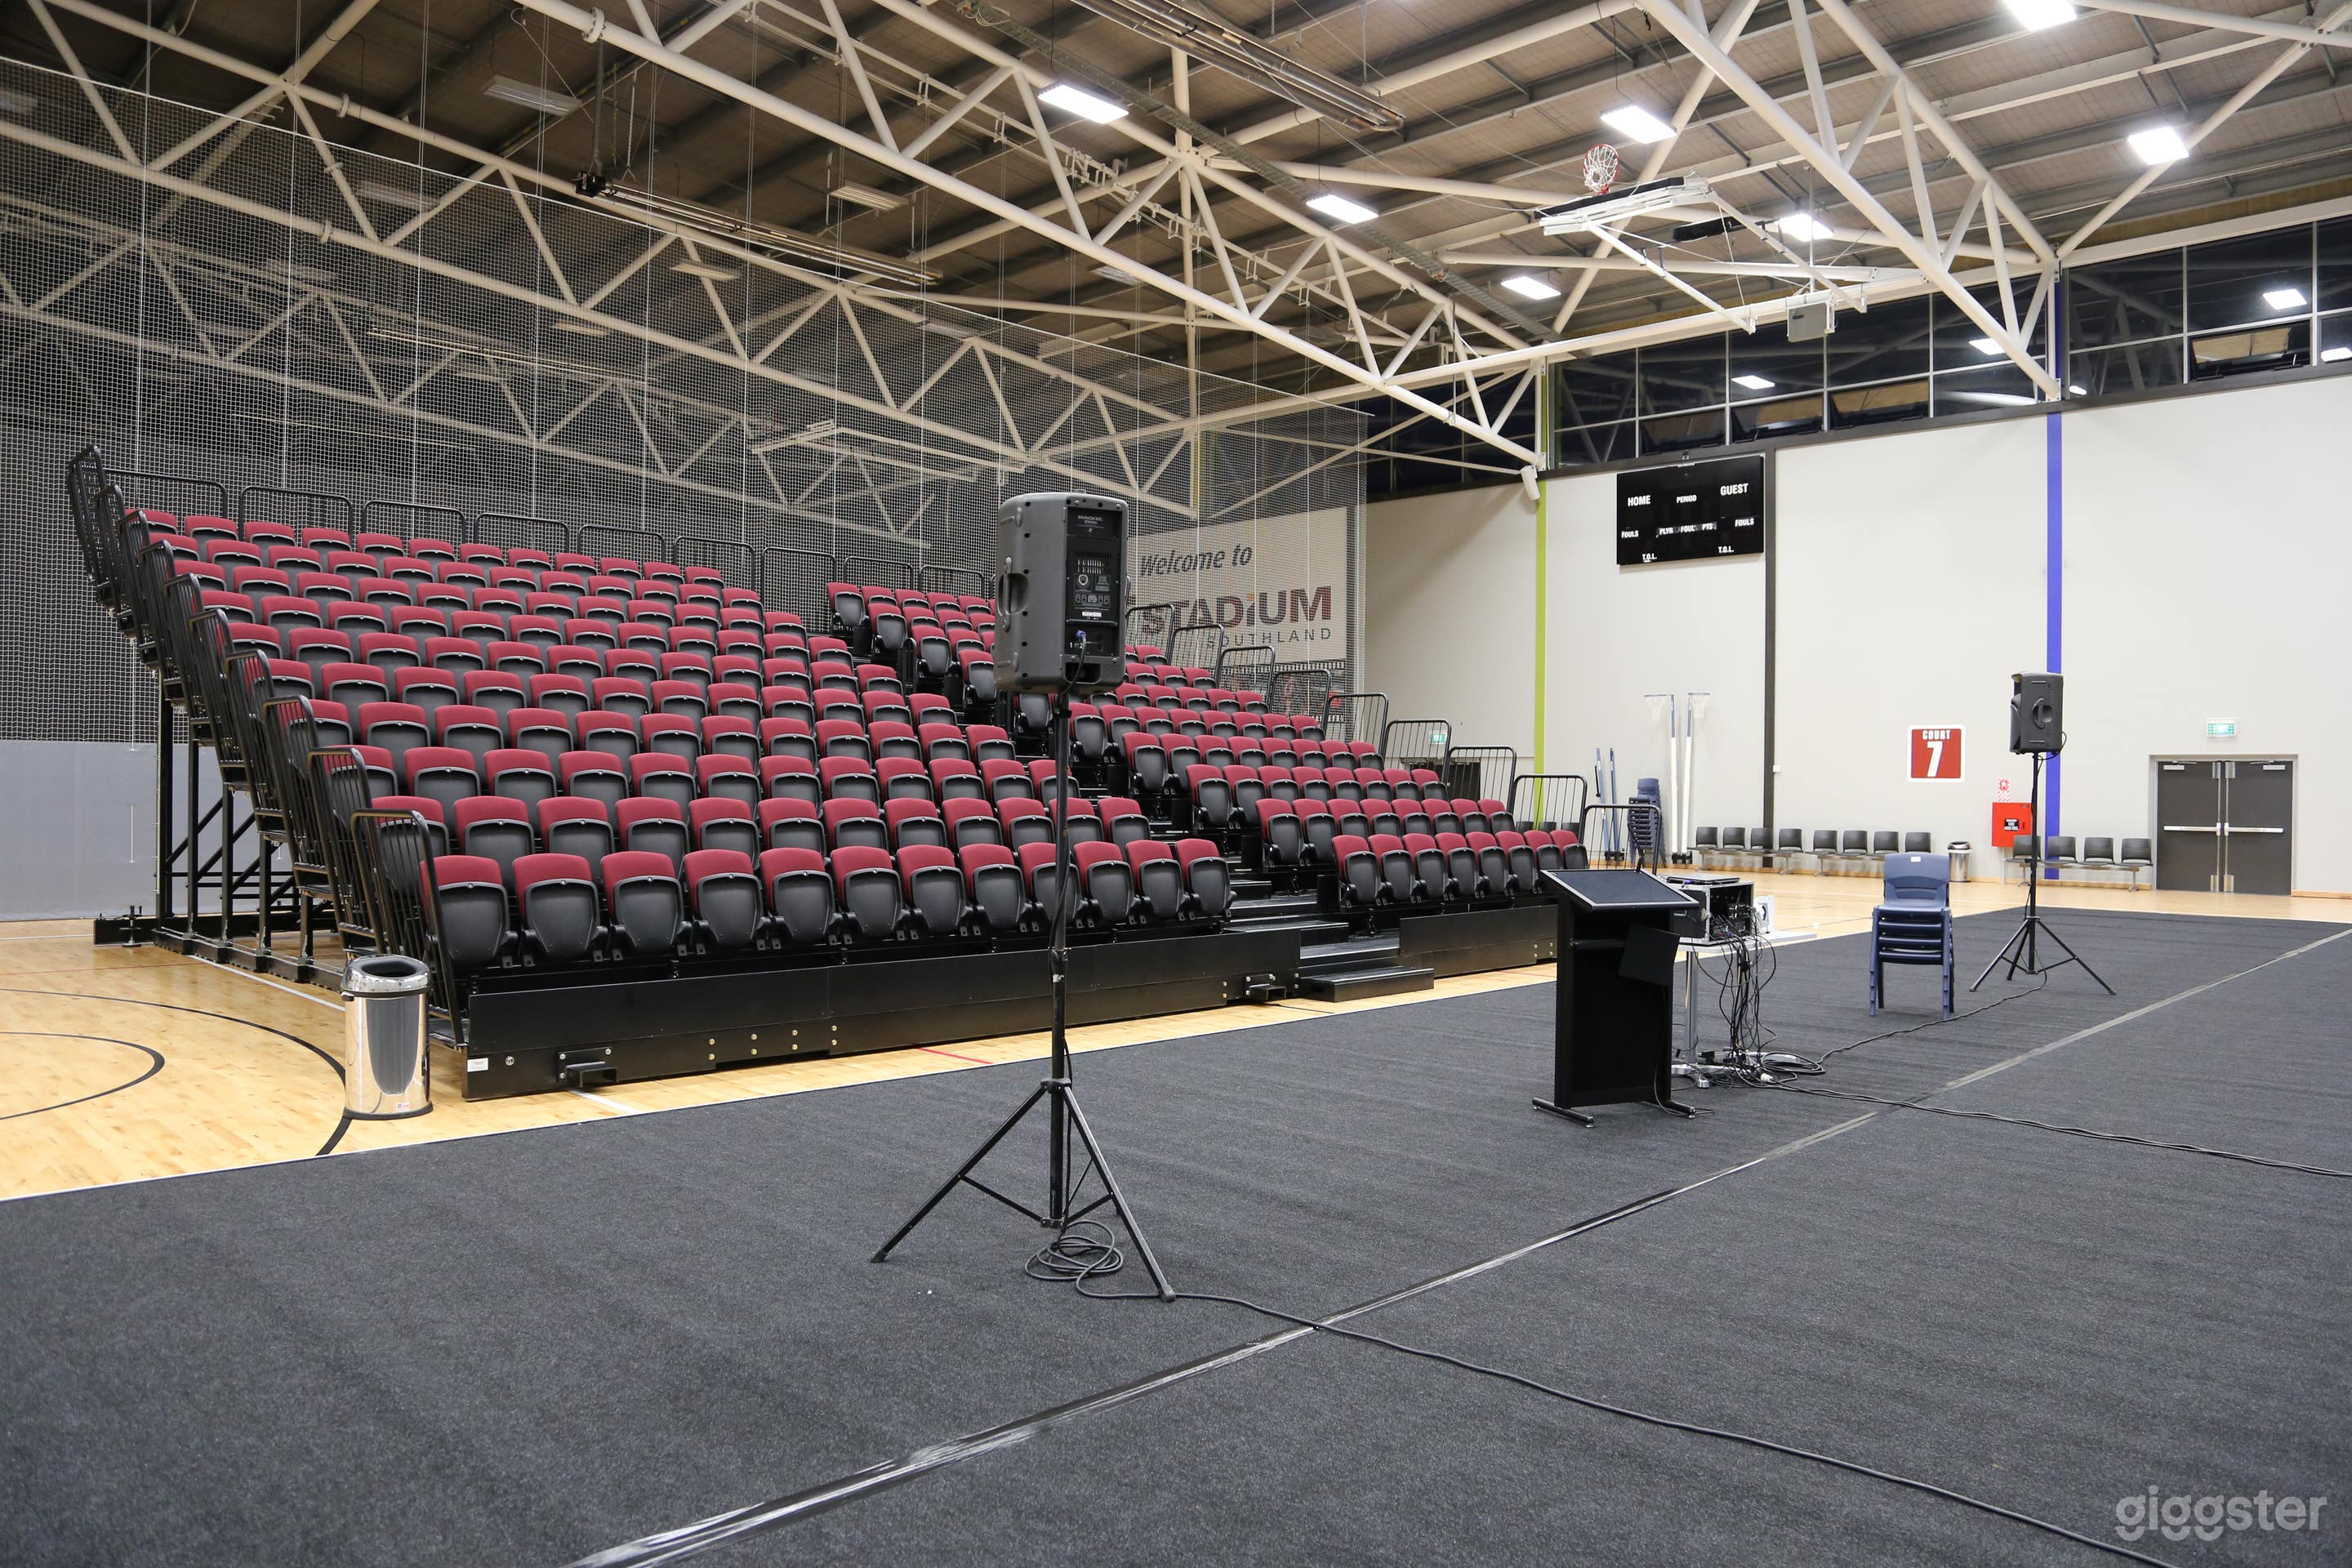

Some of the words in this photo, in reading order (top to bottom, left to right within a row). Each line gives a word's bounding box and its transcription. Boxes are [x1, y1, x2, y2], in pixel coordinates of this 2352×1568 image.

[1720, 483, 1748, 496] GUEST
[1628, 495, 1651, 506] HOME
[1677, 494, 1697, 503] PERIOD
[1735, 518, 1754, 527] FOULS
[1621, 530, 1639, 538] FOULS
[1659, 526, 1673, 535] PLYR
[1702, 523, 1713, 531] PTS
[1718, 546, 1735, 554] T.O.L.
[1141, 550, 1226, 577] Welcome
[1232, 543, 1253, 567] to
[1642, 553, 1657, 561] T.O.L.
[1922, 730, 1951, 741] COURT
[1927, 741, 1944, 777] 7
